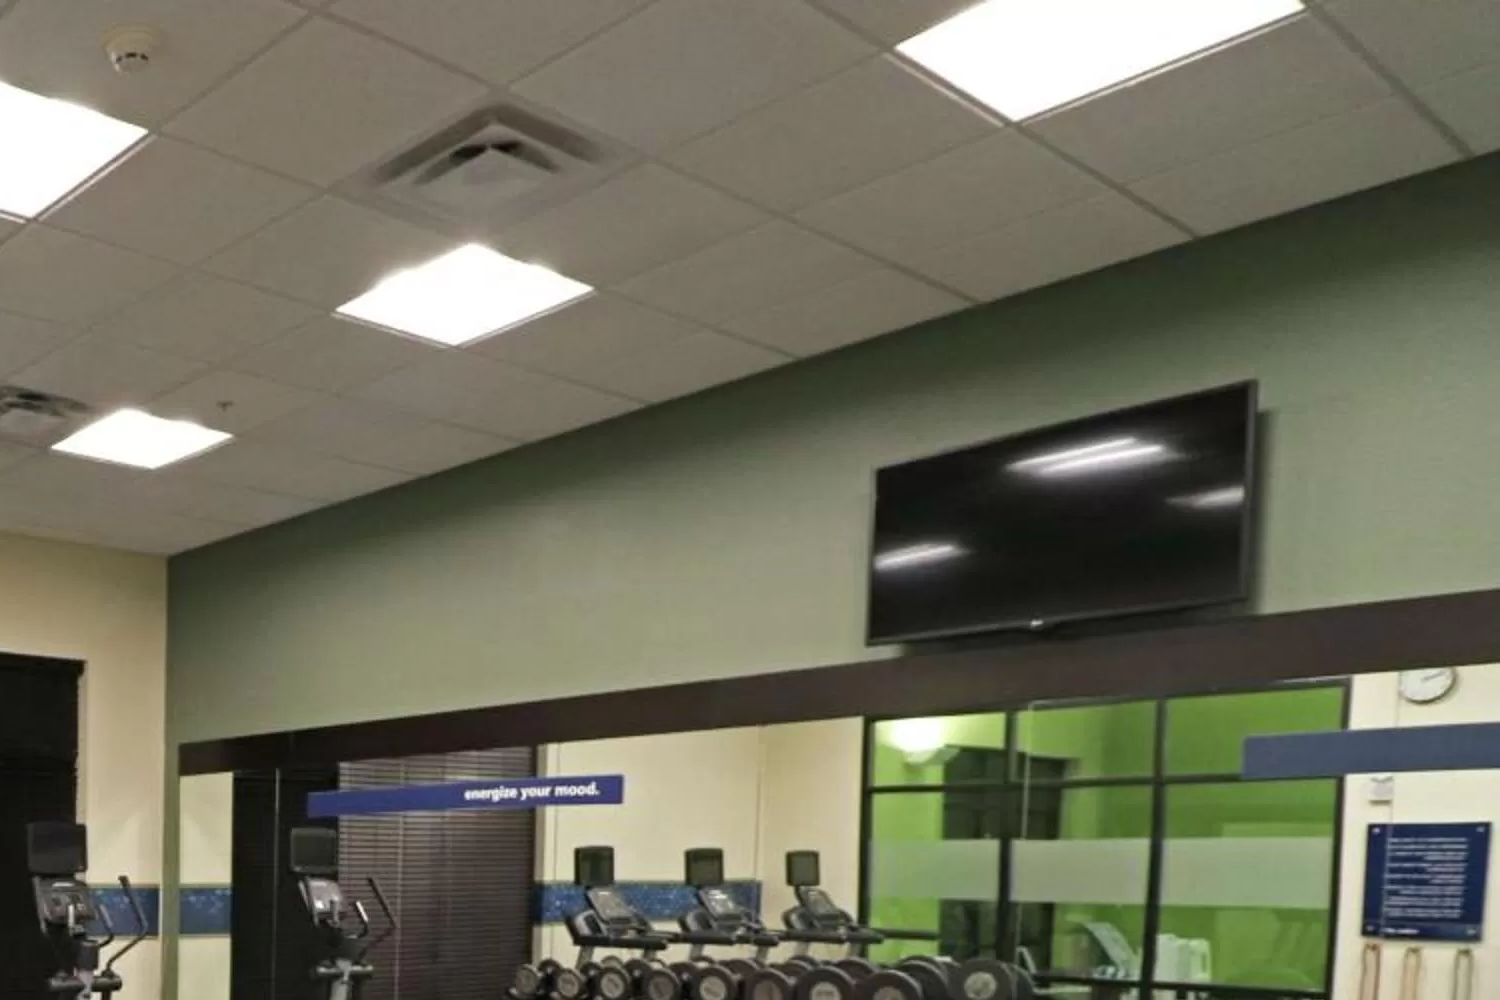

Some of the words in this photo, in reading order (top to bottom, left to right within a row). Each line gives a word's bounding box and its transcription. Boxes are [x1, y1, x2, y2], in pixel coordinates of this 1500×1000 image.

[464, 785, 517, 802] energize
[520, 786, 552, 800] your
[554, 781, 599, 797] mood.
